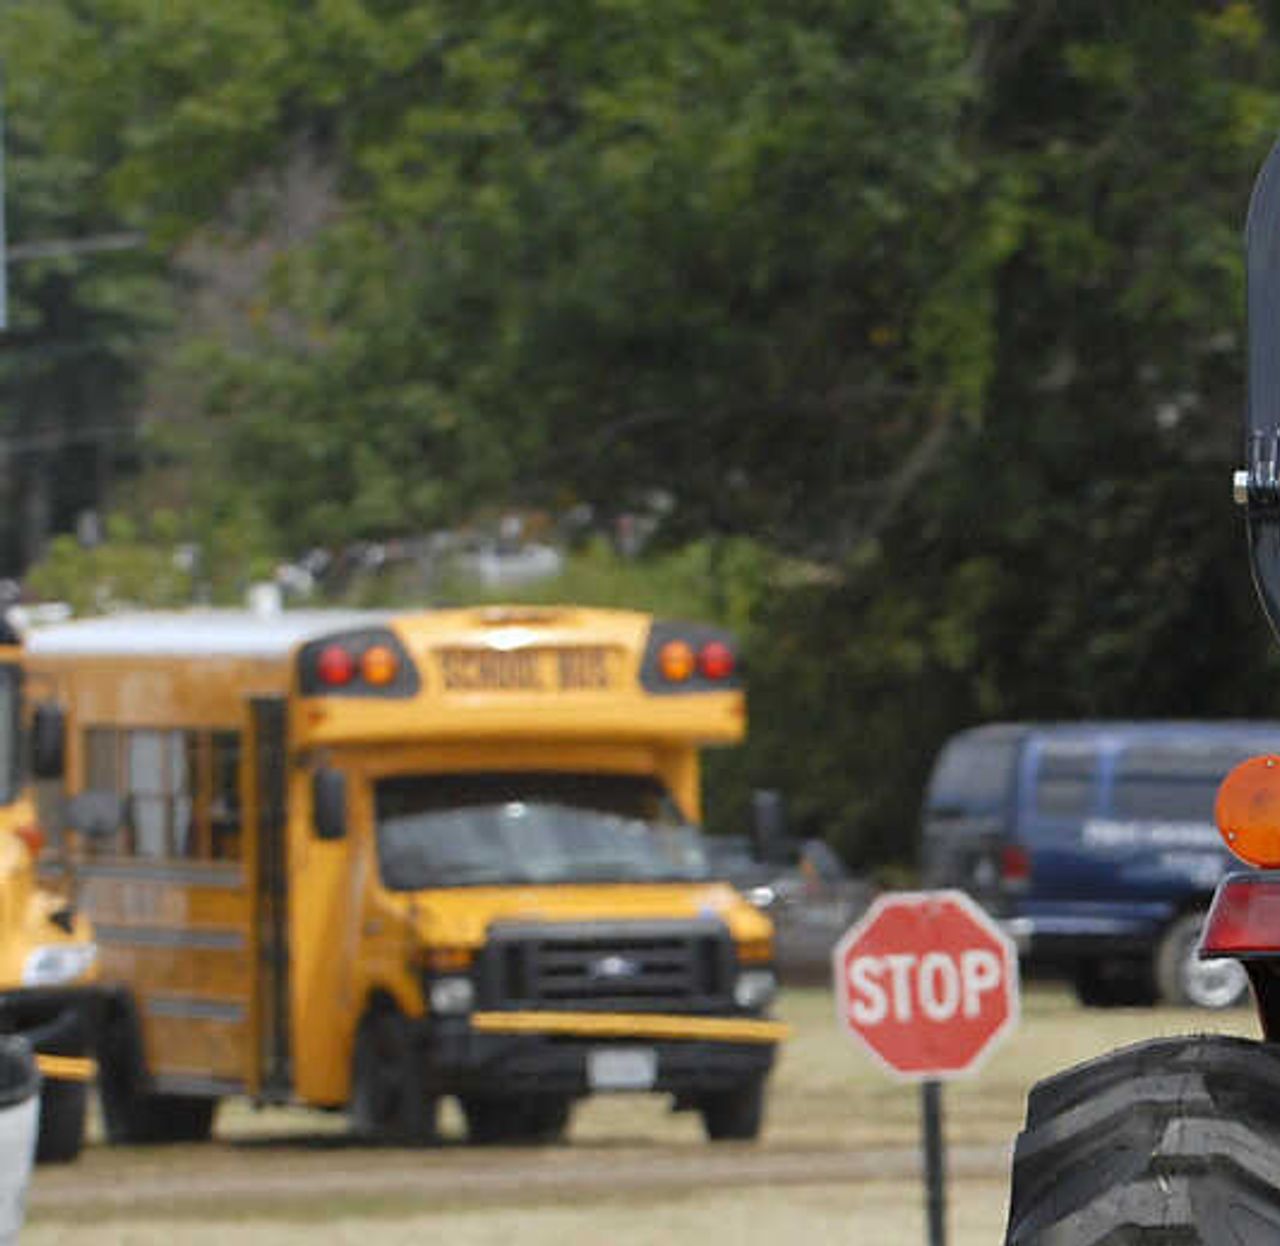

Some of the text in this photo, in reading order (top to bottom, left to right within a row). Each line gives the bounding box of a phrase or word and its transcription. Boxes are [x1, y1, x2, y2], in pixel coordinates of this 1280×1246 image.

[441, 648, 608, 688] SCHOOL BUS
[850, 950, 1001, 1026] STOP
